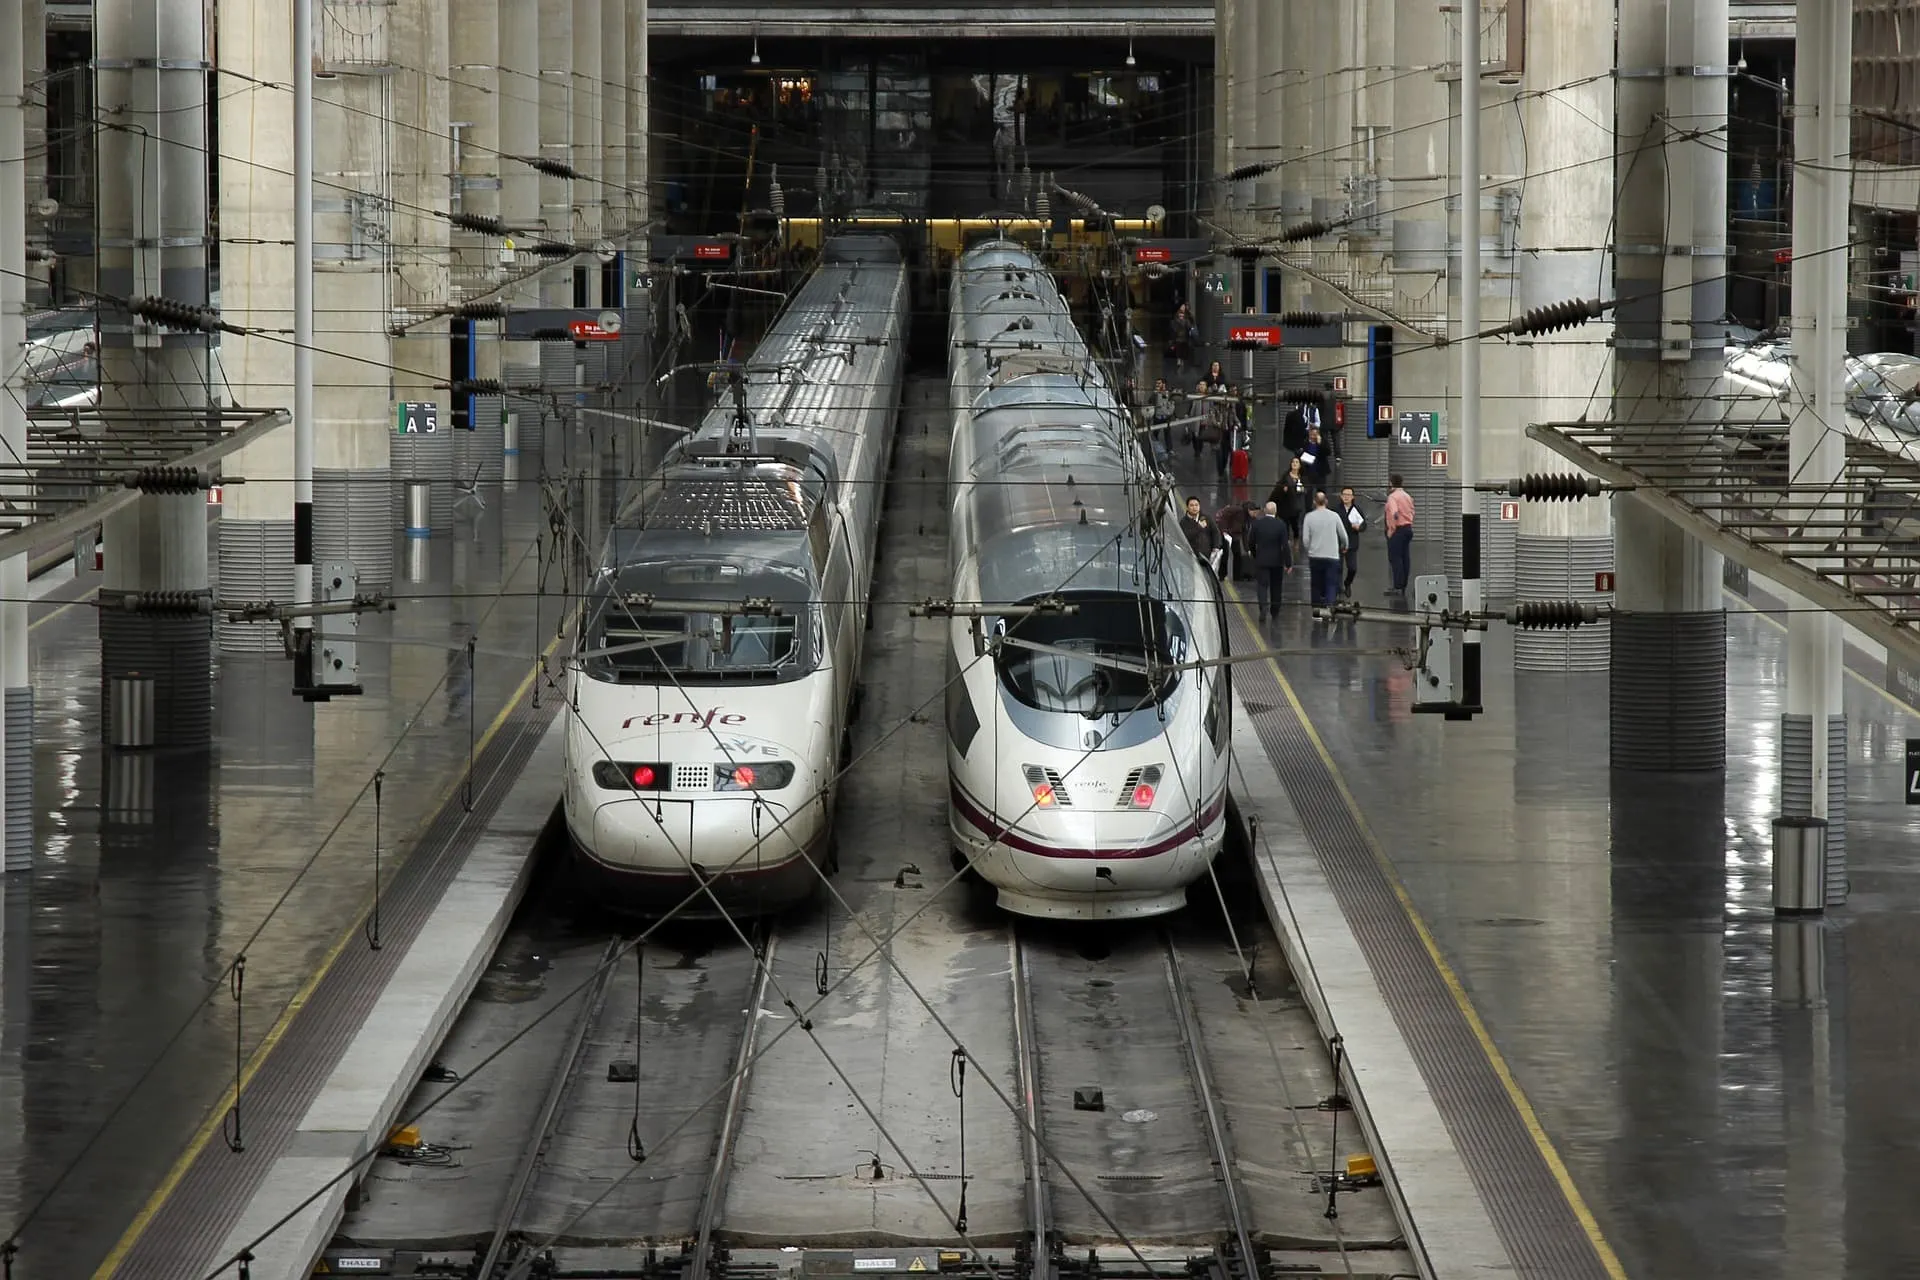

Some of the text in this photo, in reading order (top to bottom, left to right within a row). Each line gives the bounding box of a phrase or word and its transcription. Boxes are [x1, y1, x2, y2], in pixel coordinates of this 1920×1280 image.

[636, 278, 653, 288] A 5
[1205, 281, 1224, 292] 4 A
[406, 417, 436, 433] A 5
[1400, 427, 1431, 443] 4 A
[622, 706, 747, 729] renfe
[713, 738, 780, 757] AVE
